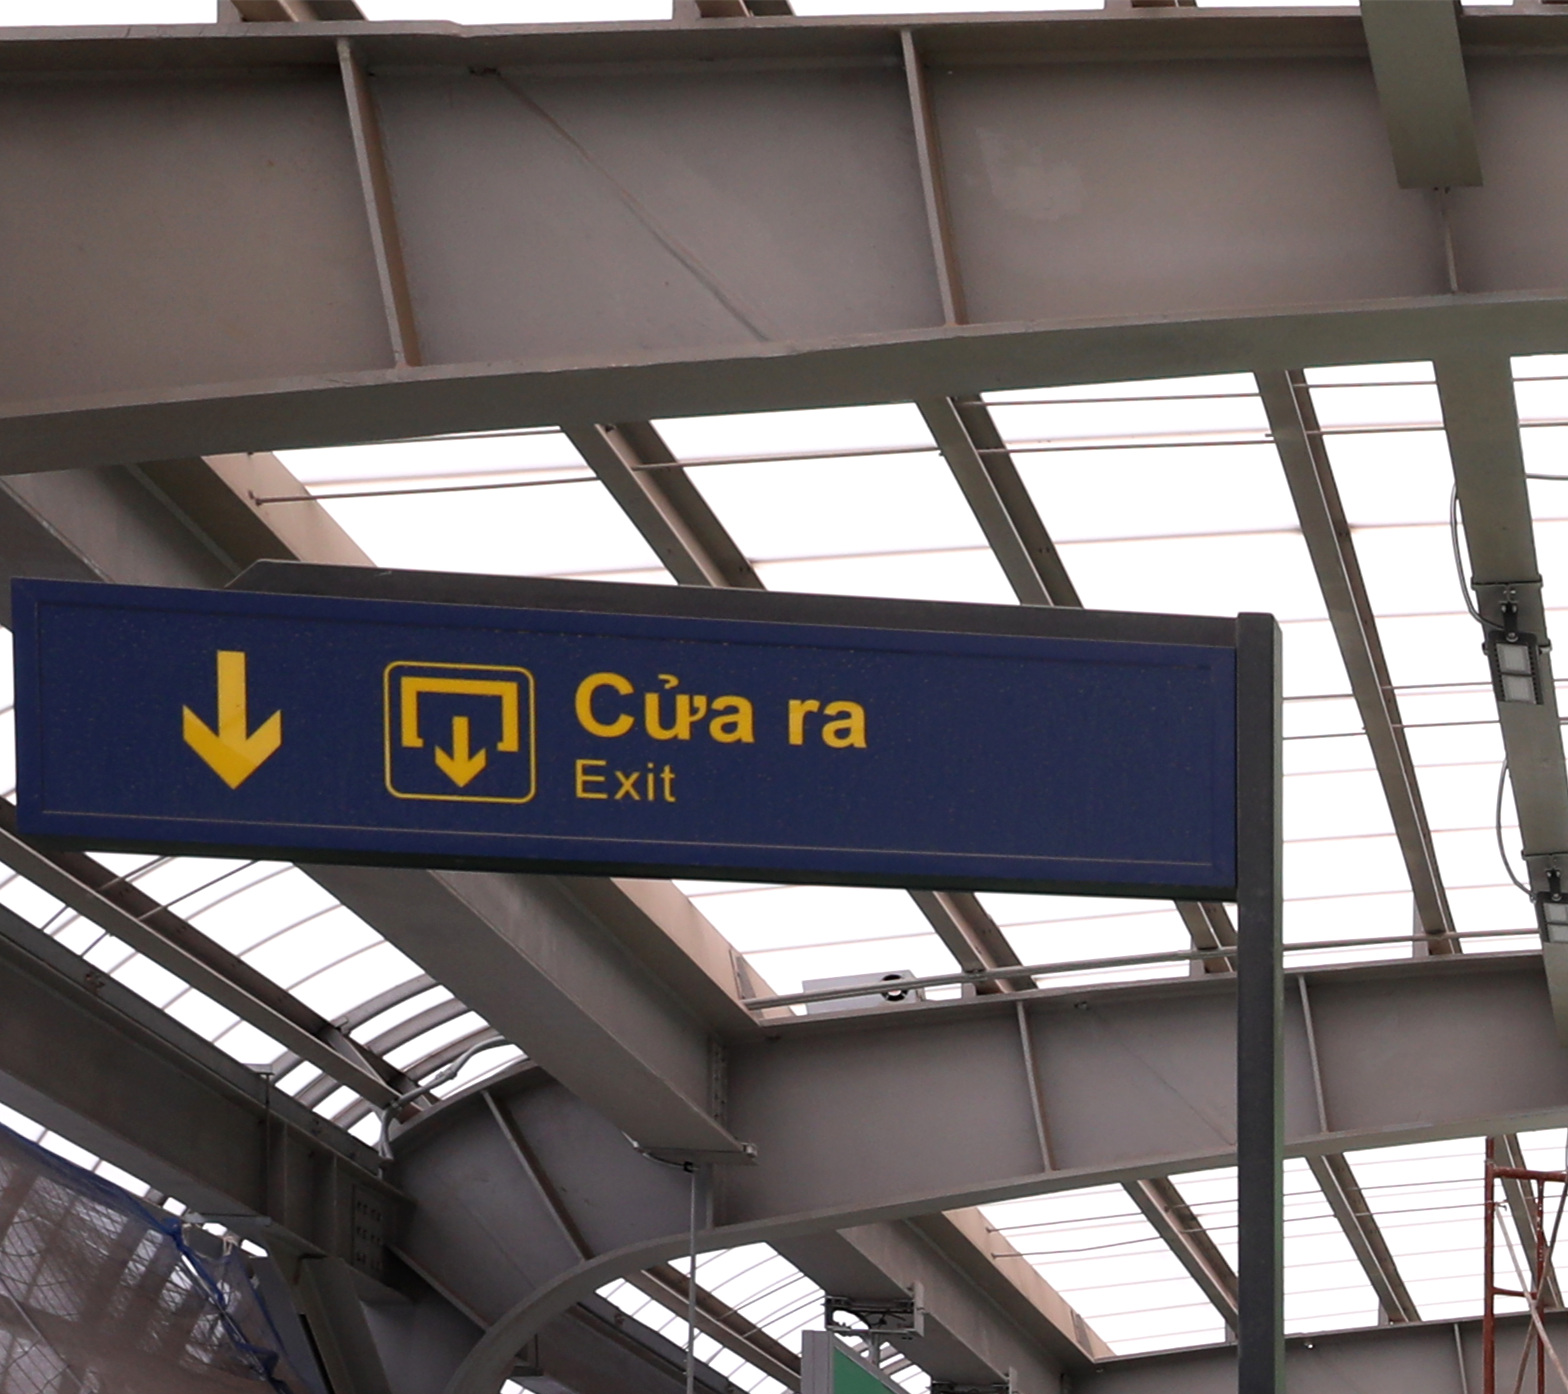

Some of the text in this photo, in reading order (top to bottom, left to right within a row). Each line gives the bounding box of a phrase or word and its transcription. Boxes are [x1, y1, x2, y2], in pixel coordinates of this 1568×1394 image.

[574, 671, 867, 748] Cửa ra
[574, 758, 676, 802] Exit
